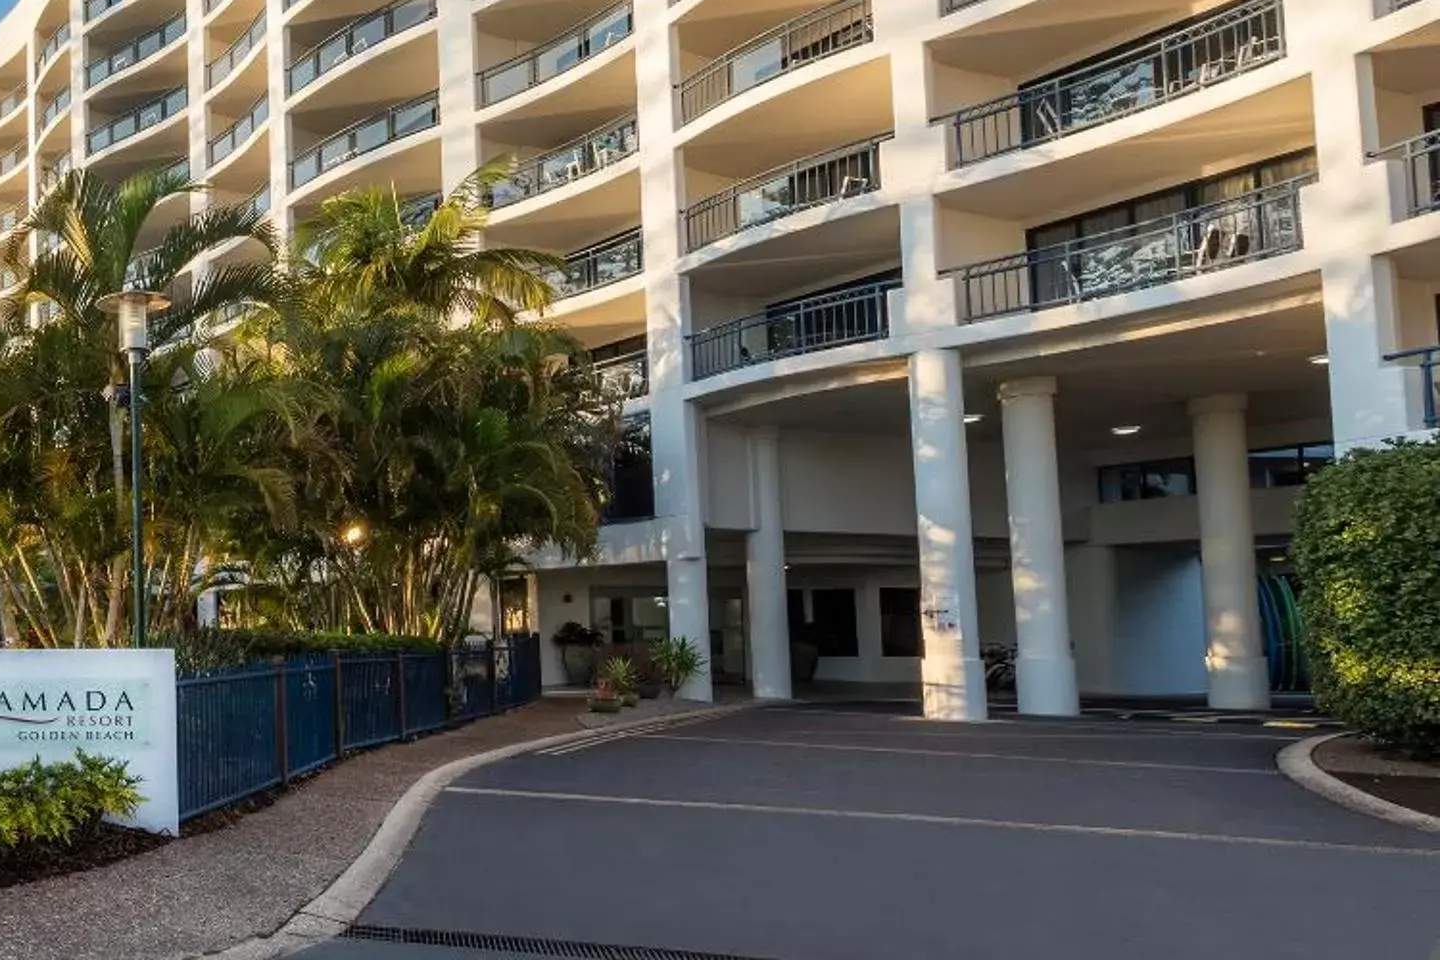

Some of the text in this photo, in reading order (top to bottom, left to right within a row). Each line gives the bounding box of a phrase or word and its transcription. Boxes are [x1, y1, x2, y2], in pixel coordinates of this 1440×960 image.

[66, 715, 133, 727] RESORT
[17, 730, 134, 741] GOLDEN BEACH
